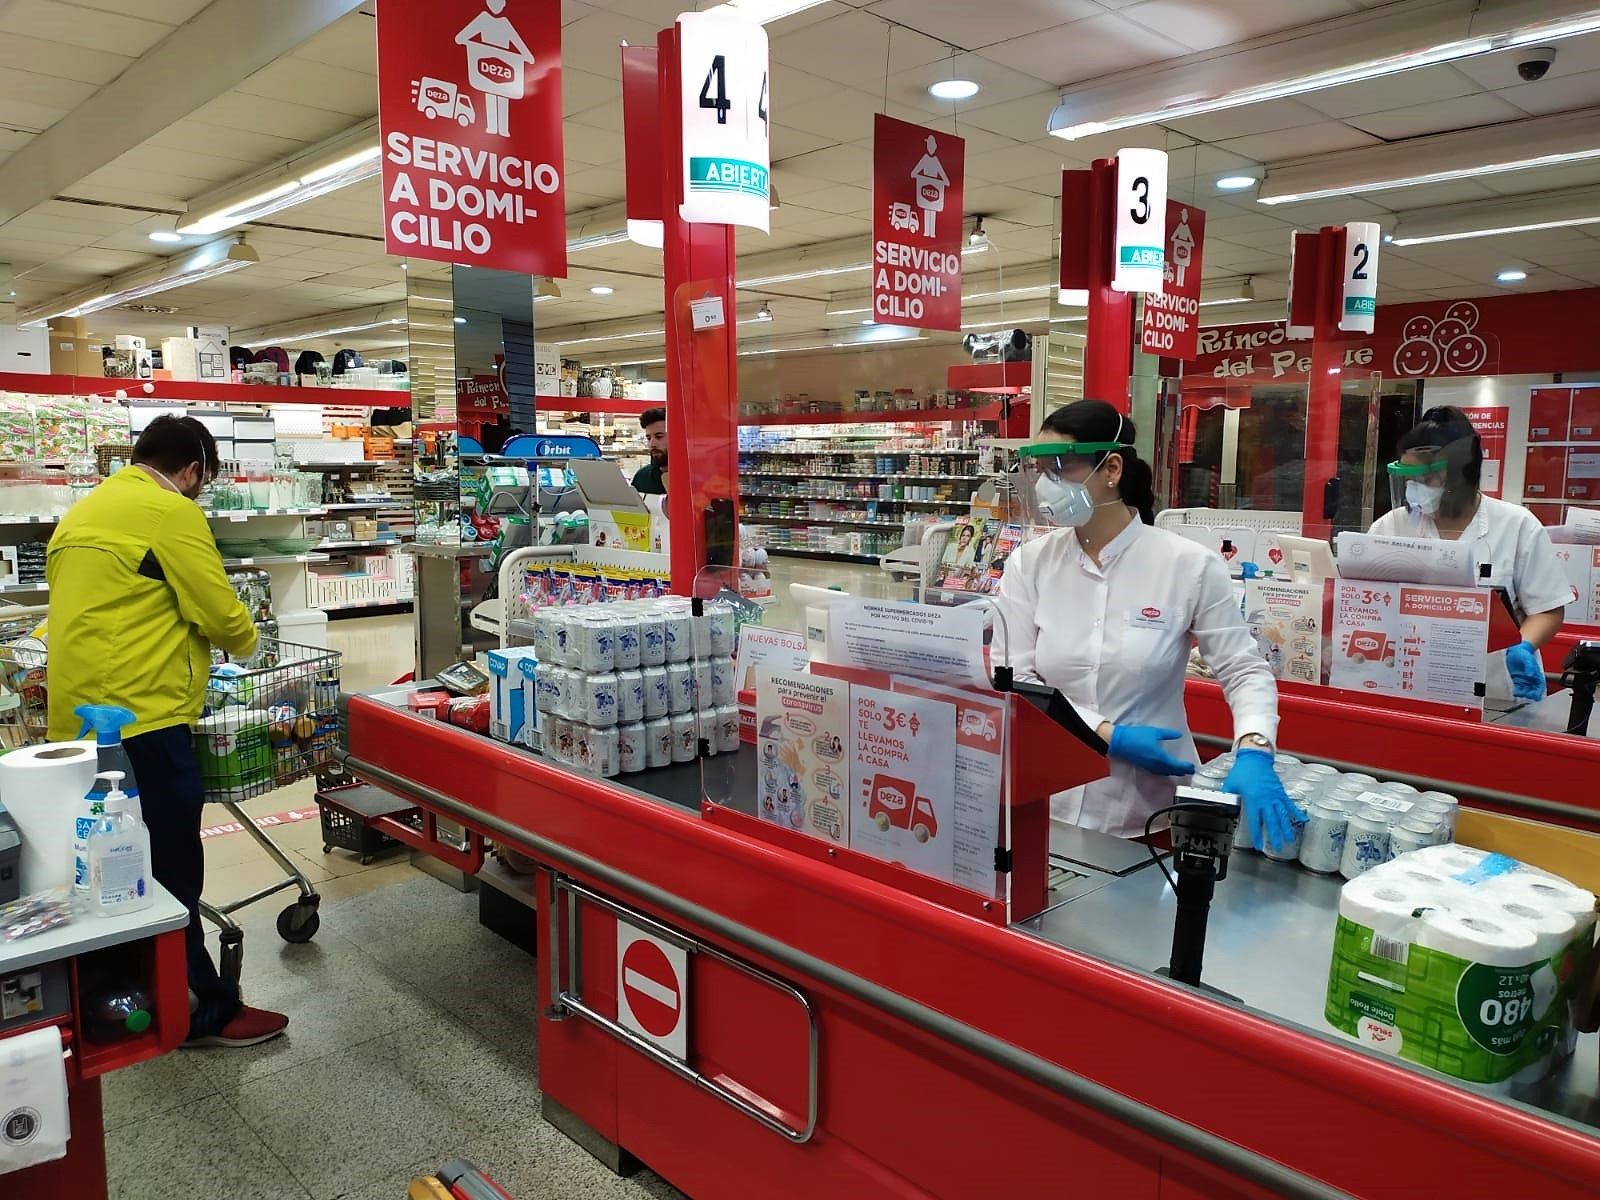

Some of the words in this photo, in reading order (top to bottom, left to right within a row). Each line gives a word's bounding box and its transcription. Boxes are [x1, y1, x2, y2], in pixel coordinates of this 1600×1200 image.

[700, 54, 730, 124] 4
[387, 132, 560, 194] SERVICIO
[389, 172, 420, 206] A
[429, 178, 537, 224] DOMI-
[1130, 176, 1150, 224] 3
[391, 212, 492, 254] CILIO
[876, 240, 958, 276] SERVICIO
[1352, 244, 1368, 280] 2
[876, 268, 890, 290] A
[894, 272, 947, 298] DOMI-
[876, 294, 924, 319] CILIO
[1146, 292, 1198, 315] SERVICIO
[1144, 310, 1153, 326] A
[1156, 312, 1189, 332] DOMI-
[1144, 330, 1173, 350] CILIO
[1214, 356, 1254, 378] del
[1404, 594, 1452, 604] SERVICIO
[1412, 603, 1452, 611] DOMICILIO
[747, 632, 779, 647] NUEVAS
[771, 676, 834, 696] RECOMENDACIONES
[778, 687, 792, 696] para
[793, 690, 819, 702] prevenir
[783, 698, 822, 712] coronavirus
[858, 698, 876, 709] POR
[858, 709, 882, 721] SOLO
[858, 720, 869, 729] TE
[883, 707, 906, 731] 3€
[858, 731, 905, 750] LLEVAMOS
[857, 754, 864, 762] A
[866, 756, 890, 768] CASA
[858, 742, 869, 752] LA
[871, 745, 909, 762] COMPRA
[880, 790, 904, 805] Deza
[1350, 998, 1370, 1011] Rollo
[1371, 1006, 1394, 1020] Doble
[1480, 996, 1532, 1025] 480
